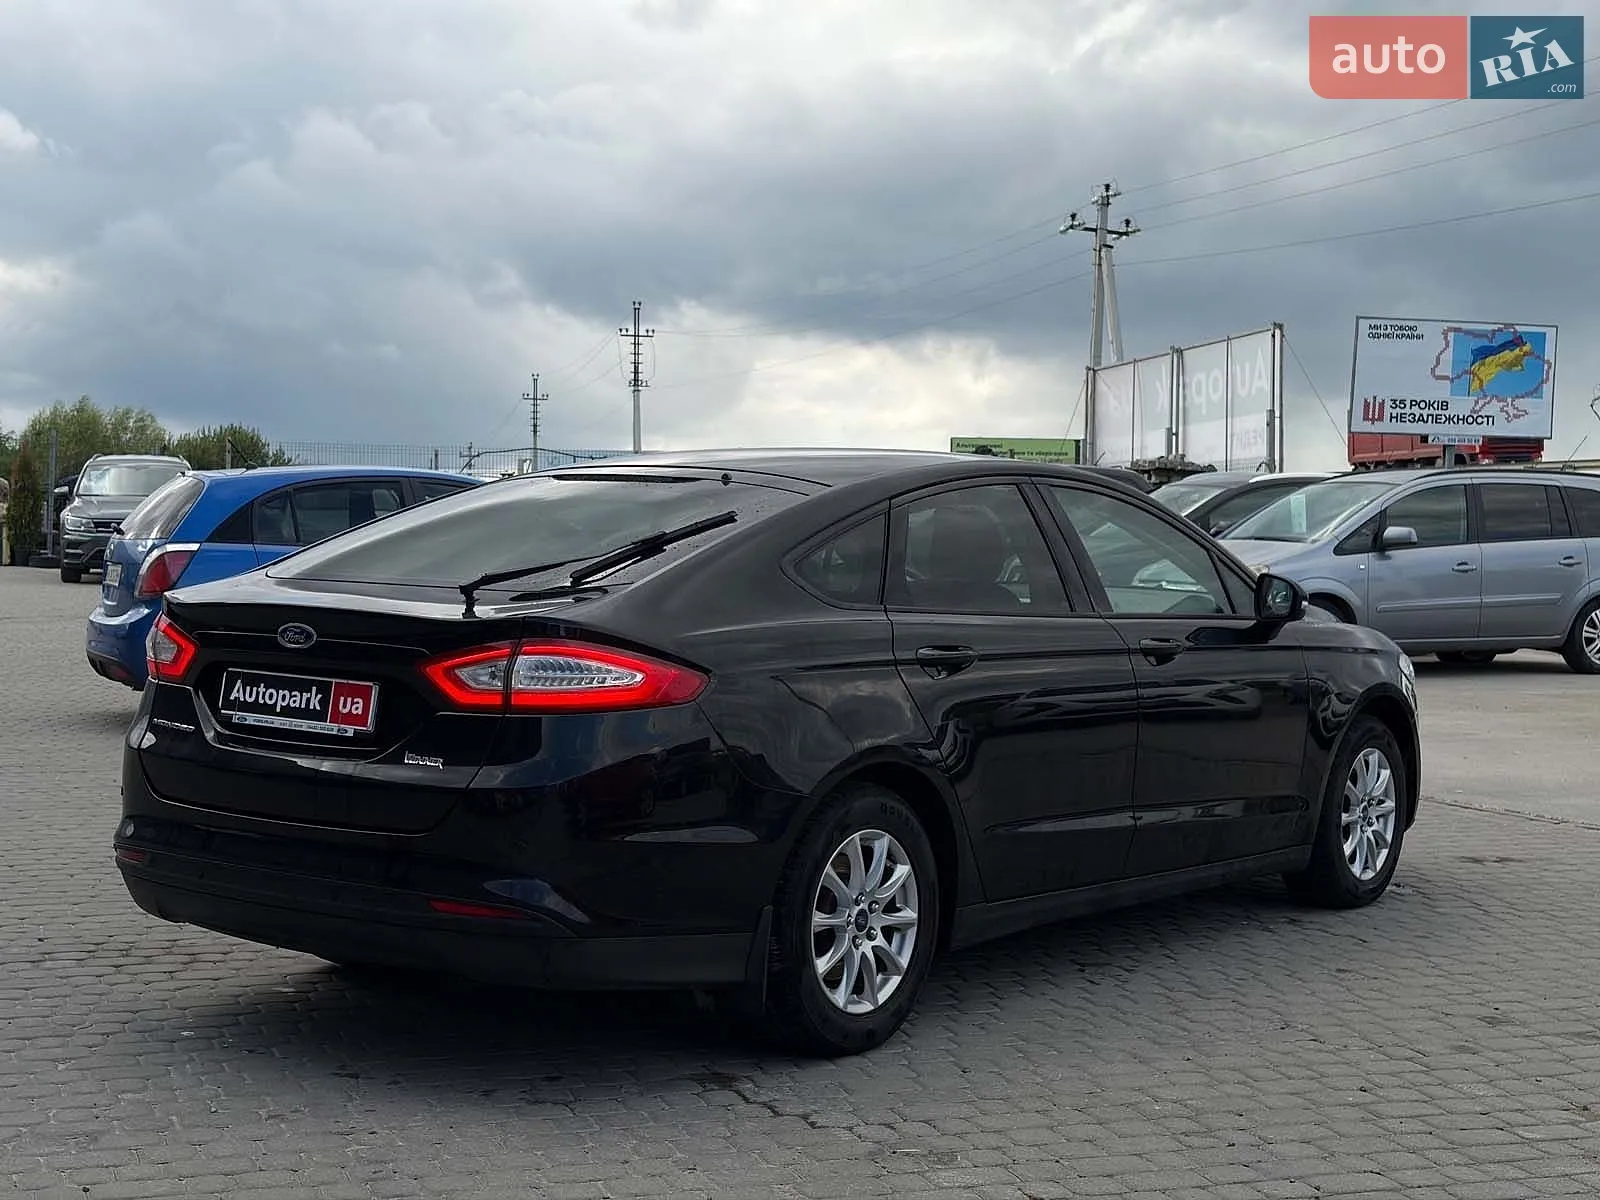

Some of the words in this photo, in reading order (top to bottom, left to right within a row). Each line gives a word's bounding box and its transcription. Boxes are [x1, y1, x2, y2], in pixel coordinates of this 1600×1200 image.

[1368, 323, 1382, 331] МИ
[1389, 324, 1418, 332] ТОБОЮ
[1368, 331, 1394, 340] ОДНІЄЇ
[1395, 332, 1424, 341] КРАЇНИ
[1389, 399, 1407, 410] 35
[1409, 399, 1449, 411] РОКІВ
[1389, 412, 1495, 426] НЕЗАЛЕЖНОСТІ
[229, 678, 323, 713] Autopark
[339, 695, 364, 715] ua
